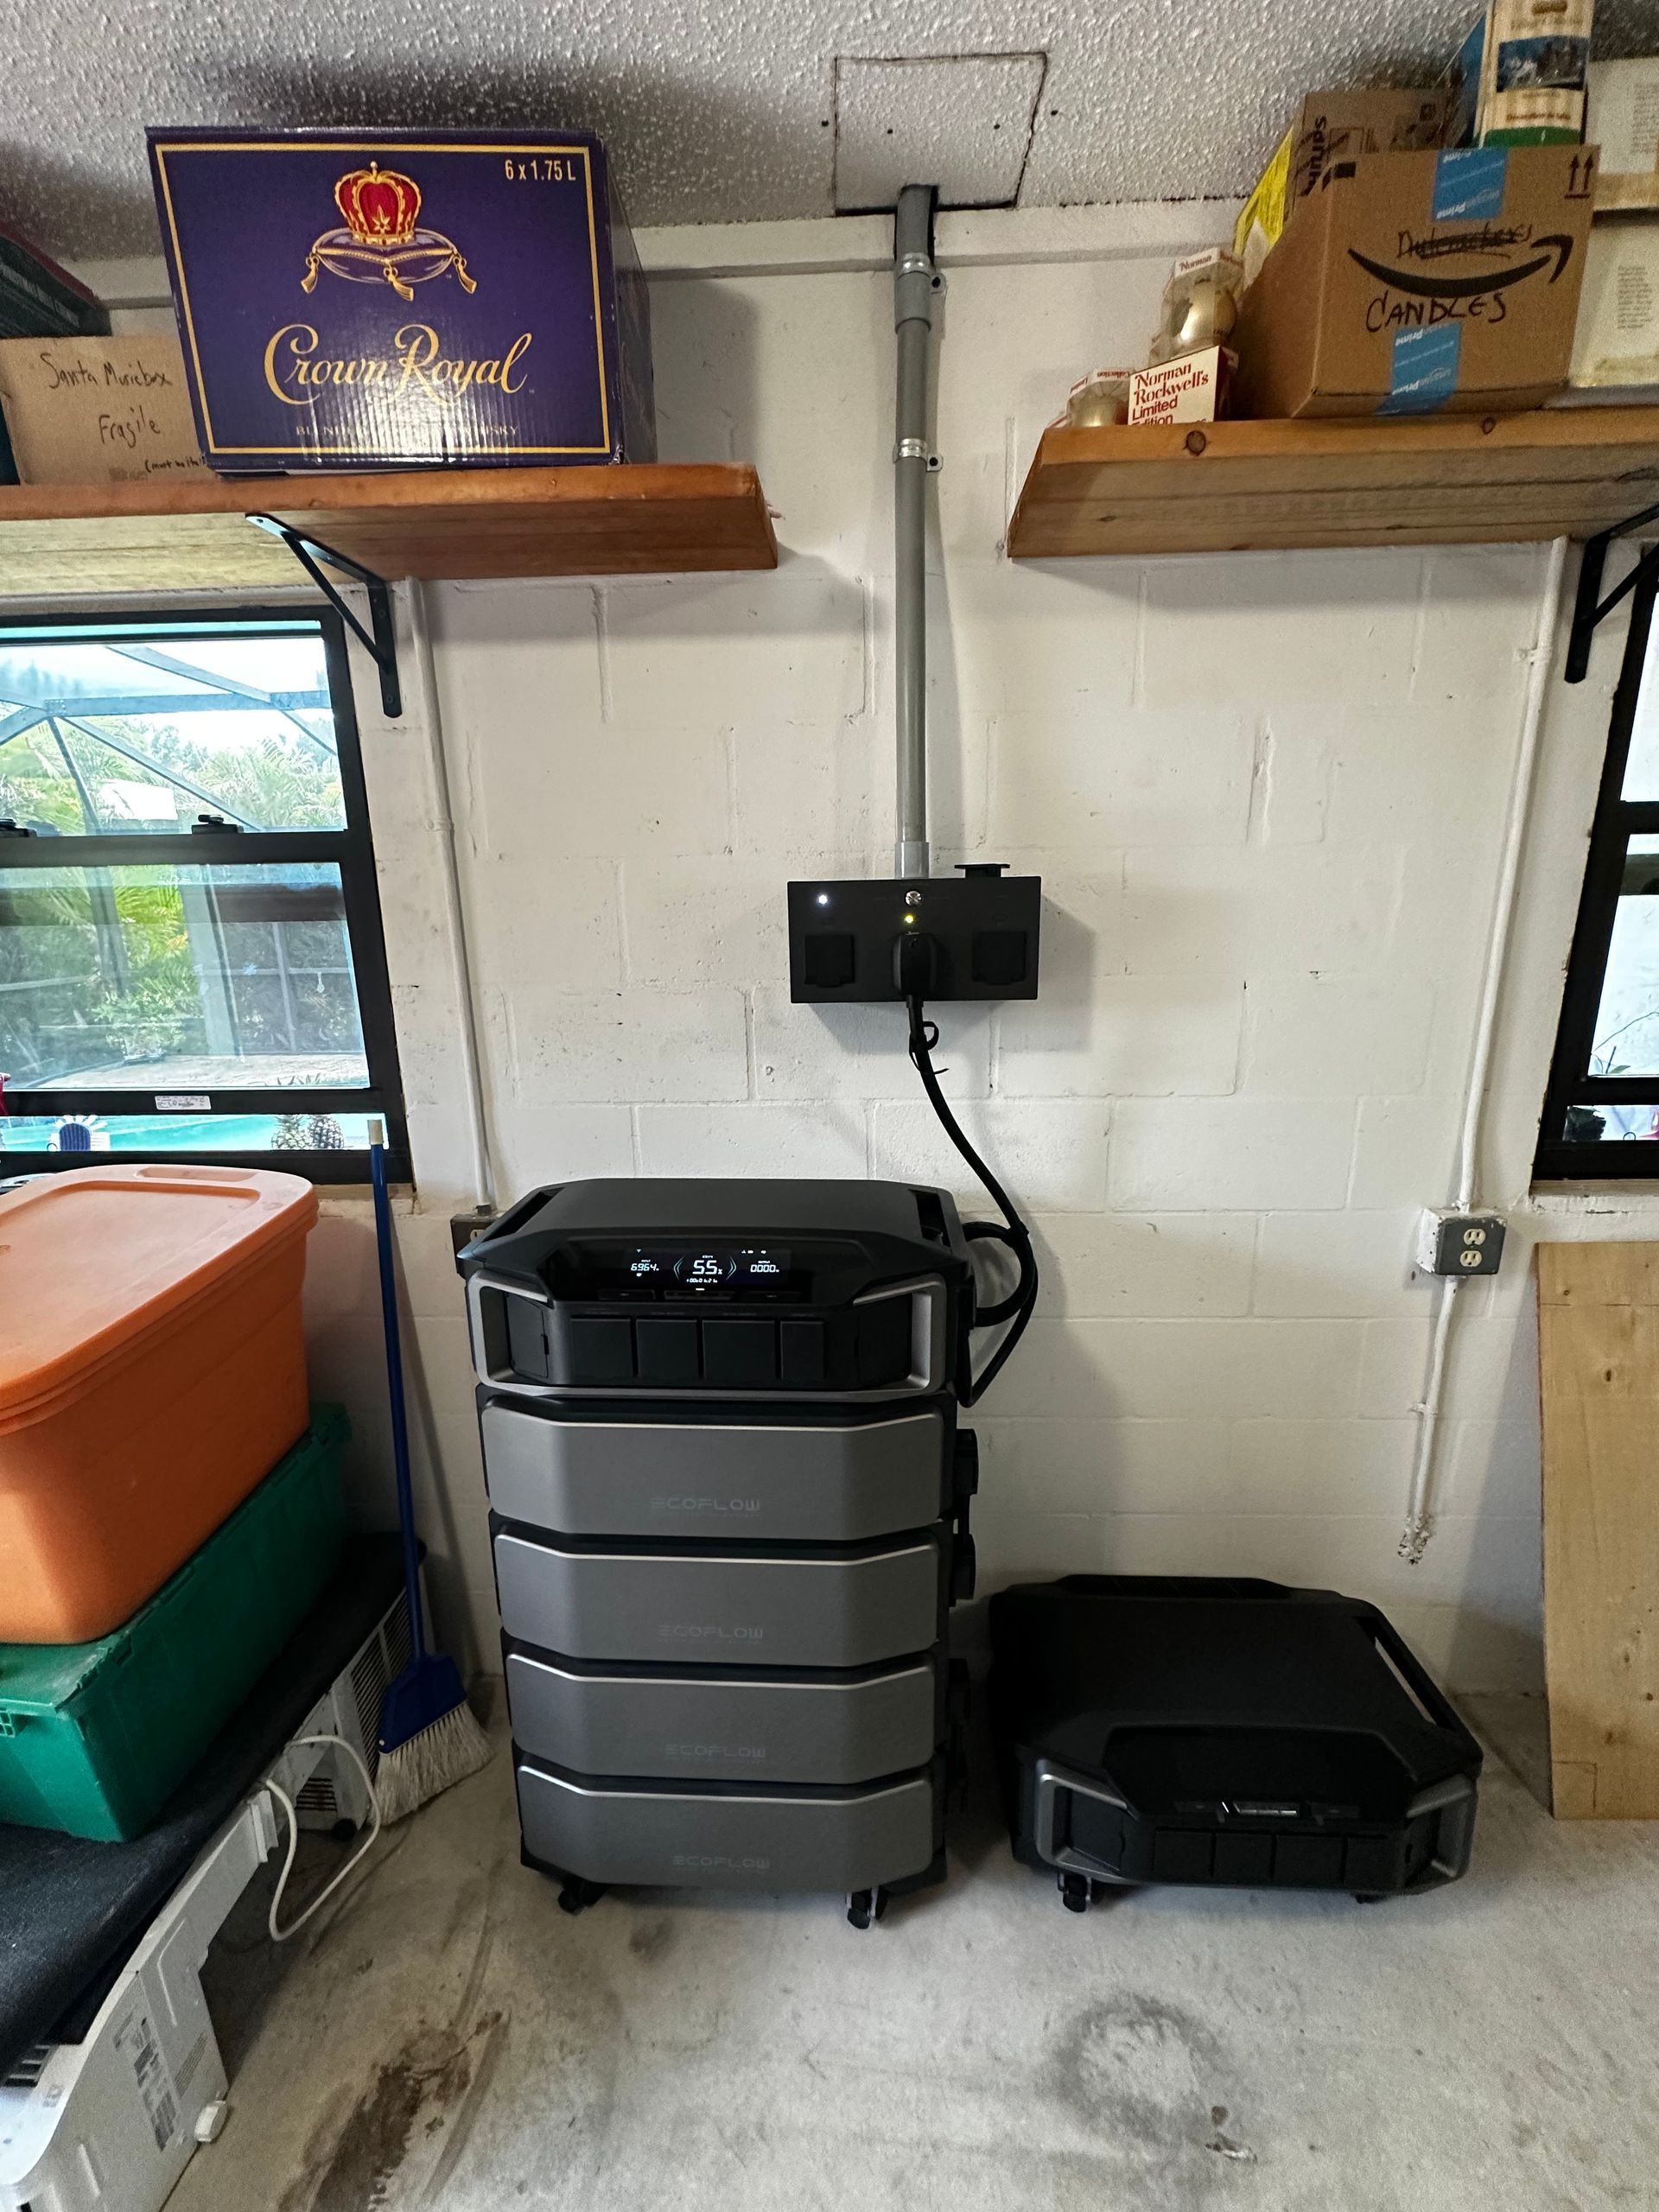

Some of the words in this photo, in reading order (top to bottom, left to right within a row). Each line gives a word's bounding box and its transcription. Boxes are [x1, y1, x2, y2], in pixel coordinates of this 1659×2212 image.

[505, 159, 514, 181] 6
[518, 164, 526, 181] x
[531, 159, 563, 181] 1.75
[567, 159, 576, 181] L
[1179, 255, 1212, 272] Norman
[1365, 290, 1506, 333] CANDLES
[1395, 328, 1423, 346] Prime
[40, 353, 98, 389] Santa
[264, 323, 388, 404] Crown
[388, 323, 532, 406] Royal
[1135, 363, 1192, 390] Norman
[1134, 370, 1209, 406] Rockwell's
[1132, 395, 1178, 421] Limited
[99, 404, 161, 448] Fragile
[649, 1497, 761, 1511] ECOFLOW
[658, 1624, 764, 1639] ECOFLOW
[664, 1744, 766, 1758] ECOFLOW
[671, 1855, 770, 1869] ECOFLOW
